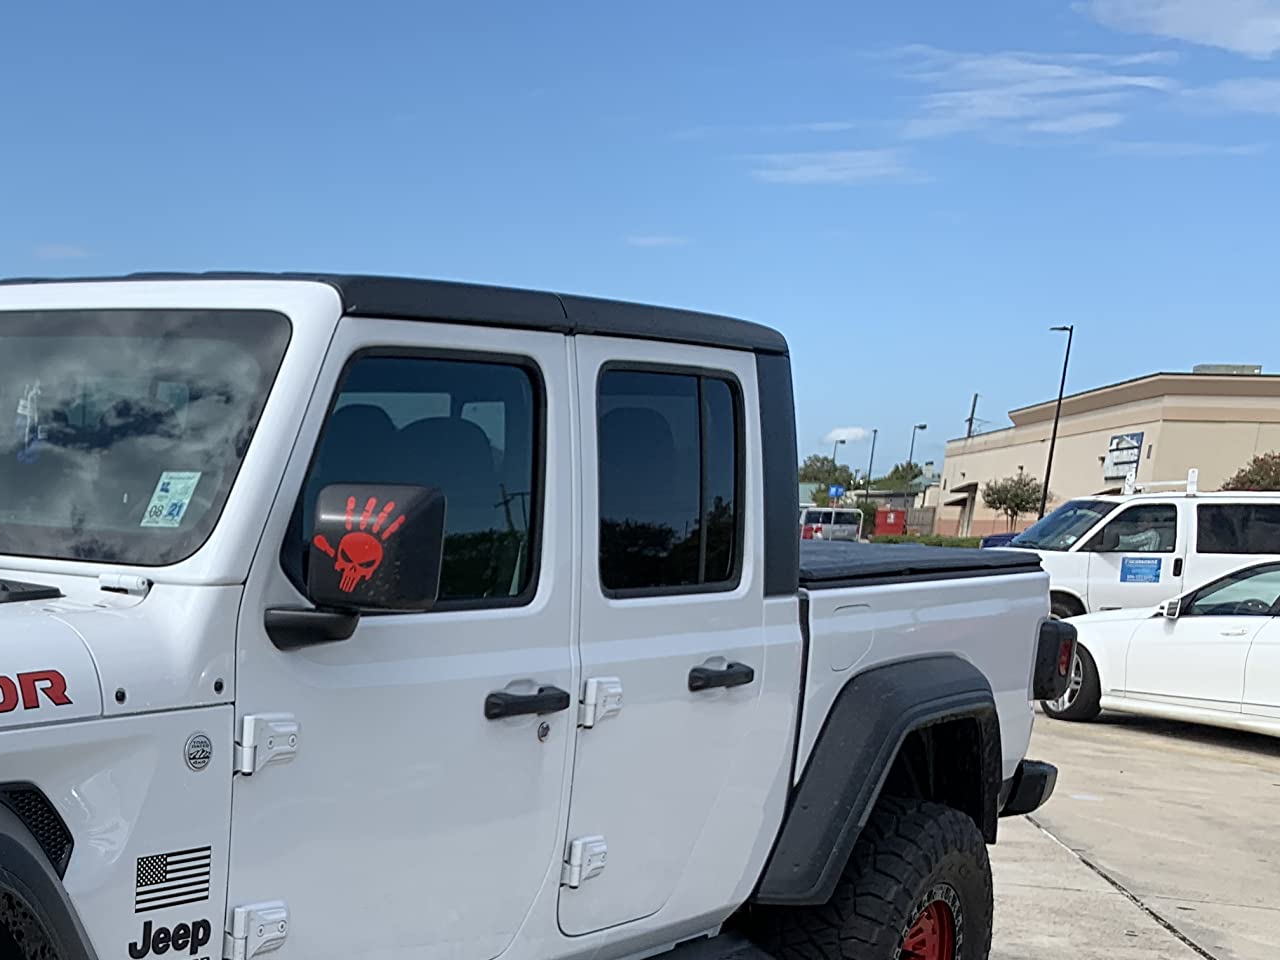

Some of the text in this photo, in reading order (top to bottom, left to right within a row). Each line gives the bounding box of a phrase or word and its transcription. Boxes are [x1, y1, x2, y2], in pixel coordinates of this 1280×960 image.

[149, 502, 185, 518] 08 21
[128, 918, 212, 960] Jeep
